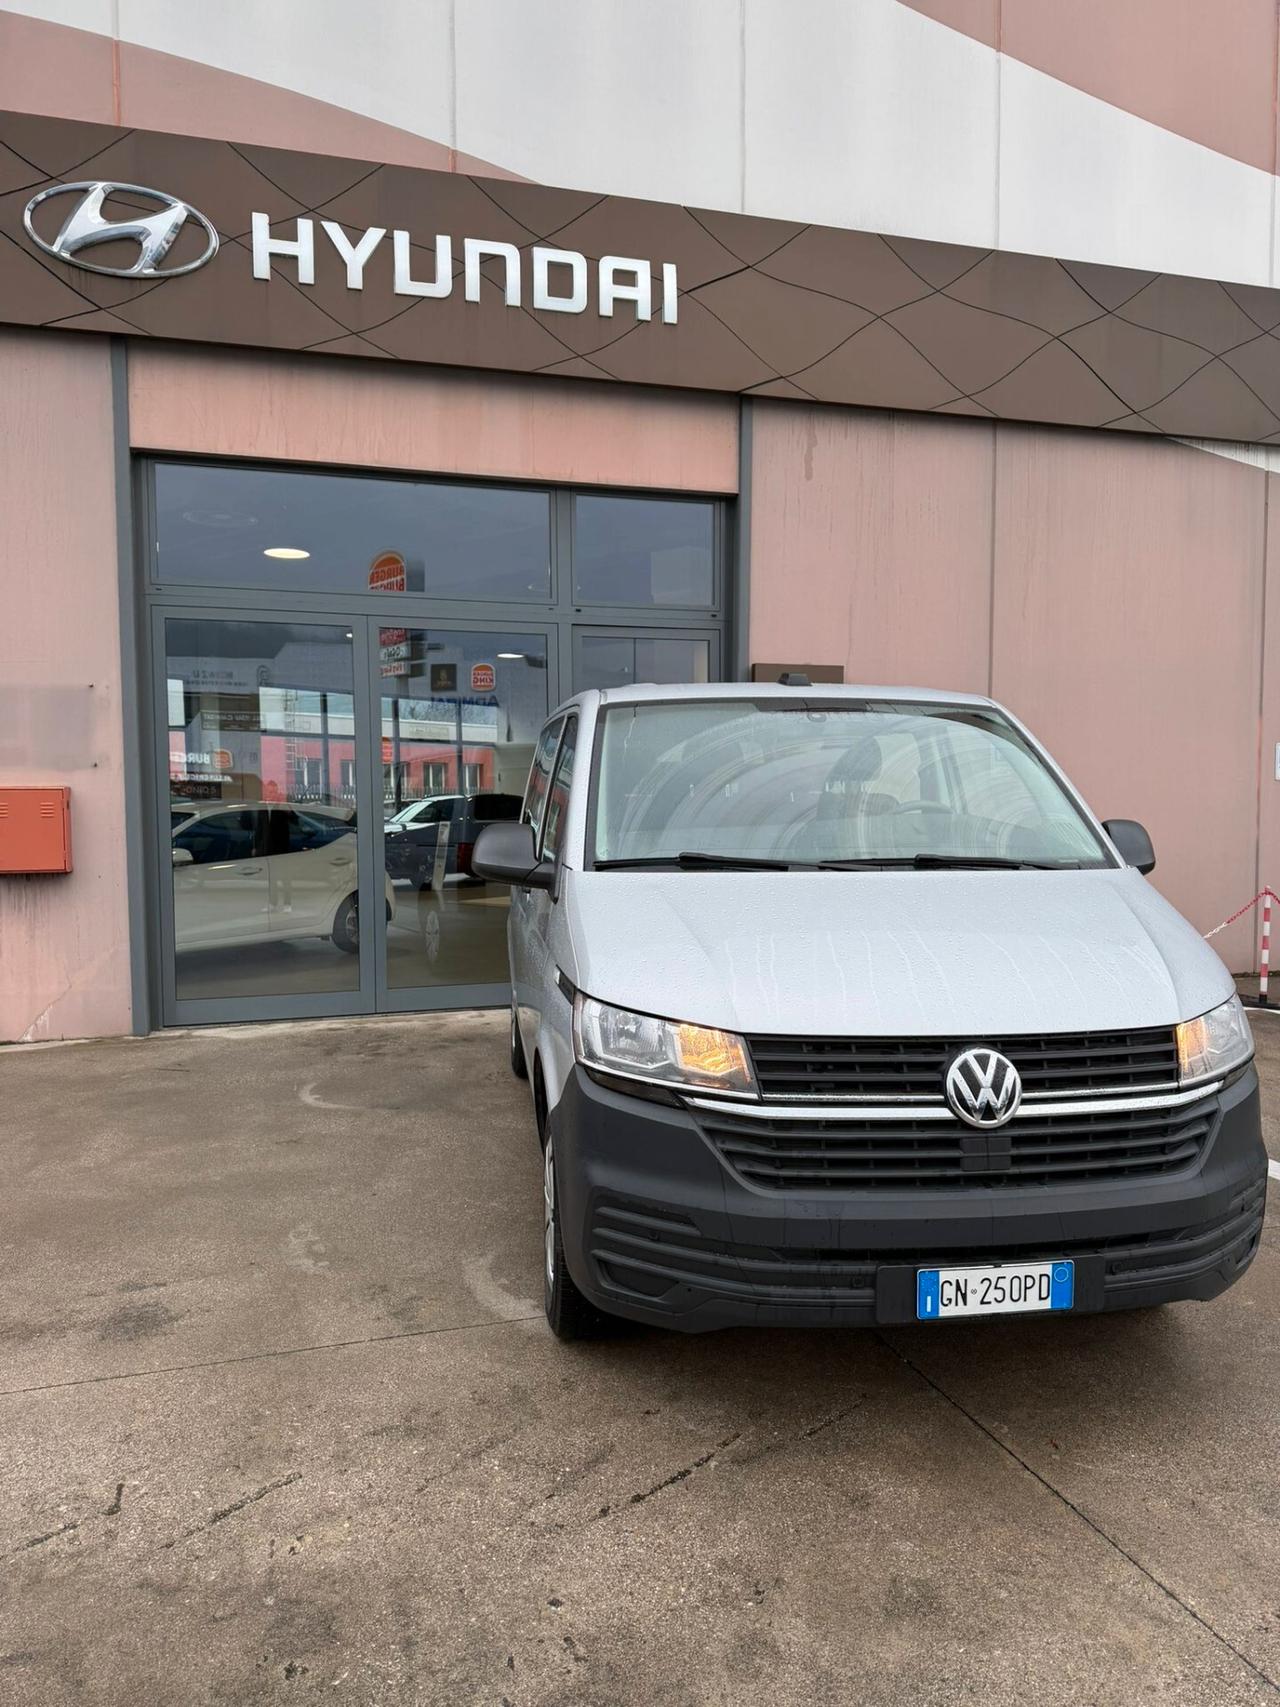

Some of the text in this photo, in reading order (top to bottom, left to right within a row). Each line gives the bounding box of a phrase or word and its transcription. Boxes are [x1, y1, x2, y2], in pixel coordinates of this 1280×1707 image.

[251, 211, 678, 326] HYUNDAI
[940, 1278, 967, 1307] GN
[979, 1273, 1051, 1305] 250PD
